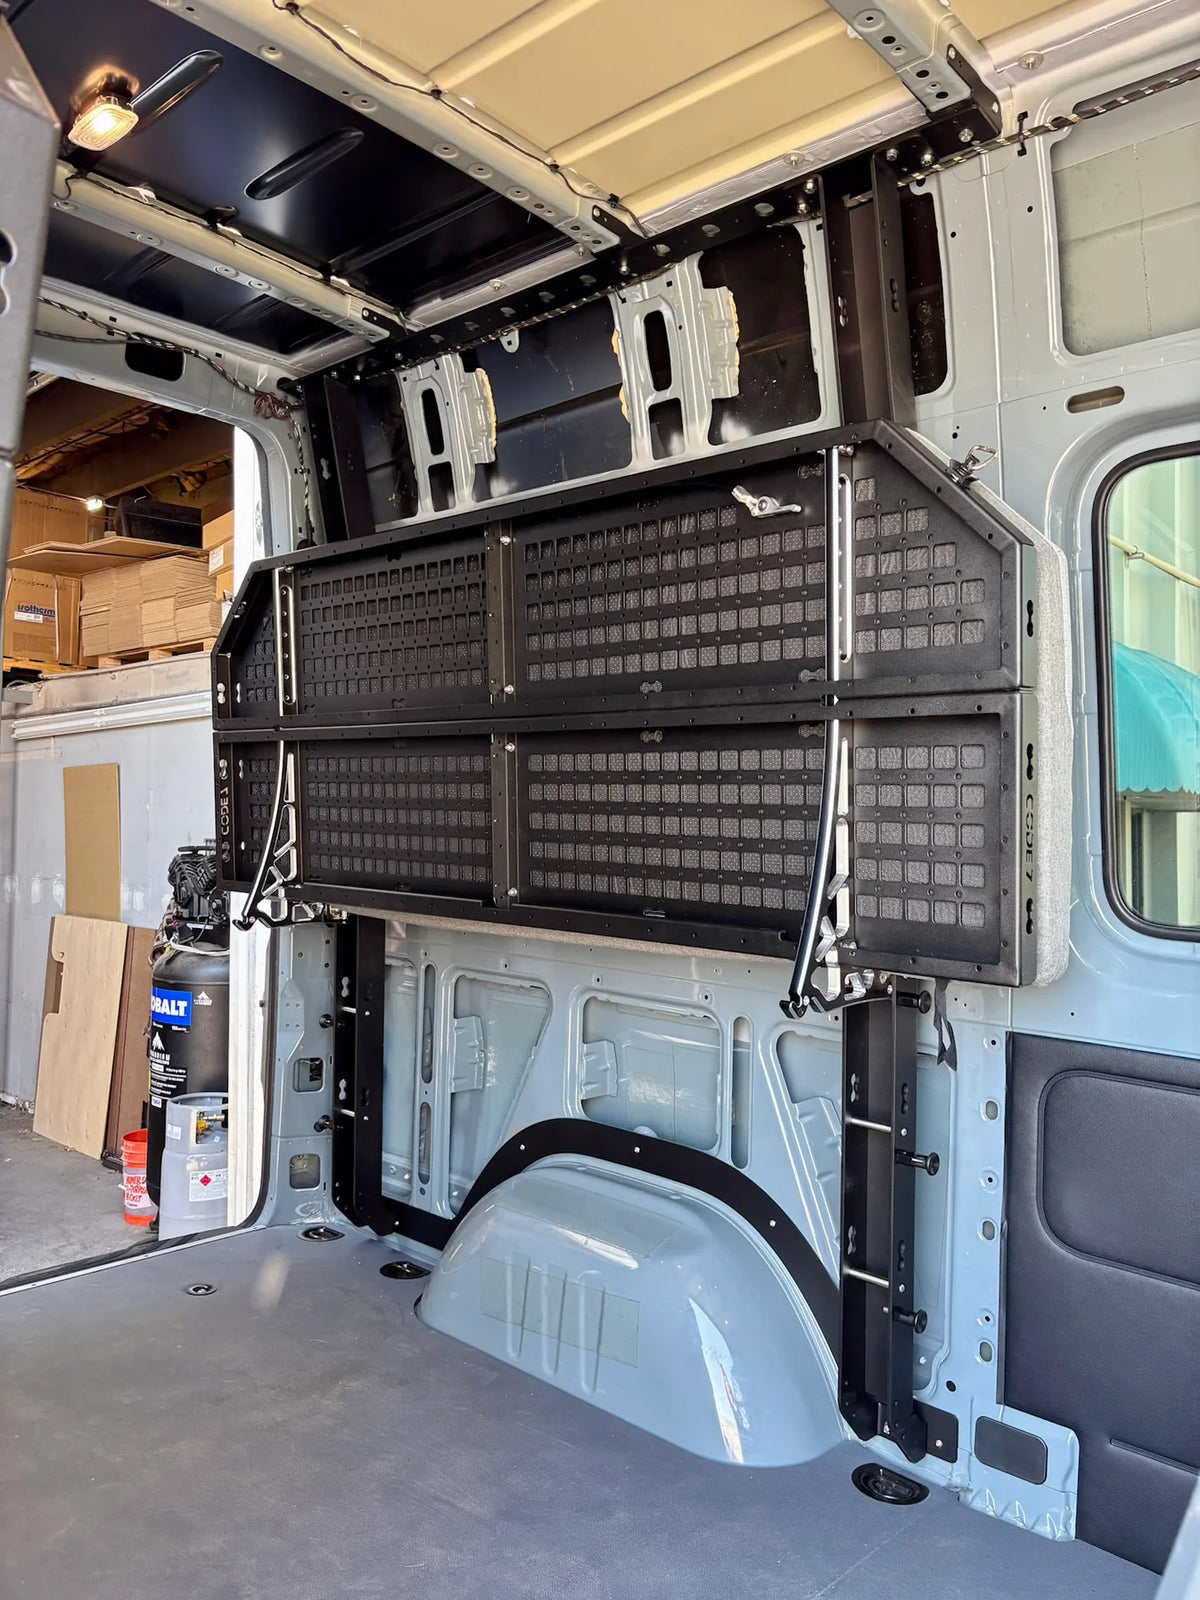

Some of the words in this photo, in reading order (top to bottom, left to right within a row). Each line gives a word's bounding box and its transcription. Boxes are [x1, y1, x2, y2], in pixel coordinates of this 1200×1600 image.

[1025, 794, 1034, 864] CODE
[1025, 868, 1034, 882] 7
[151, 996, 187, 1017] OBALT
